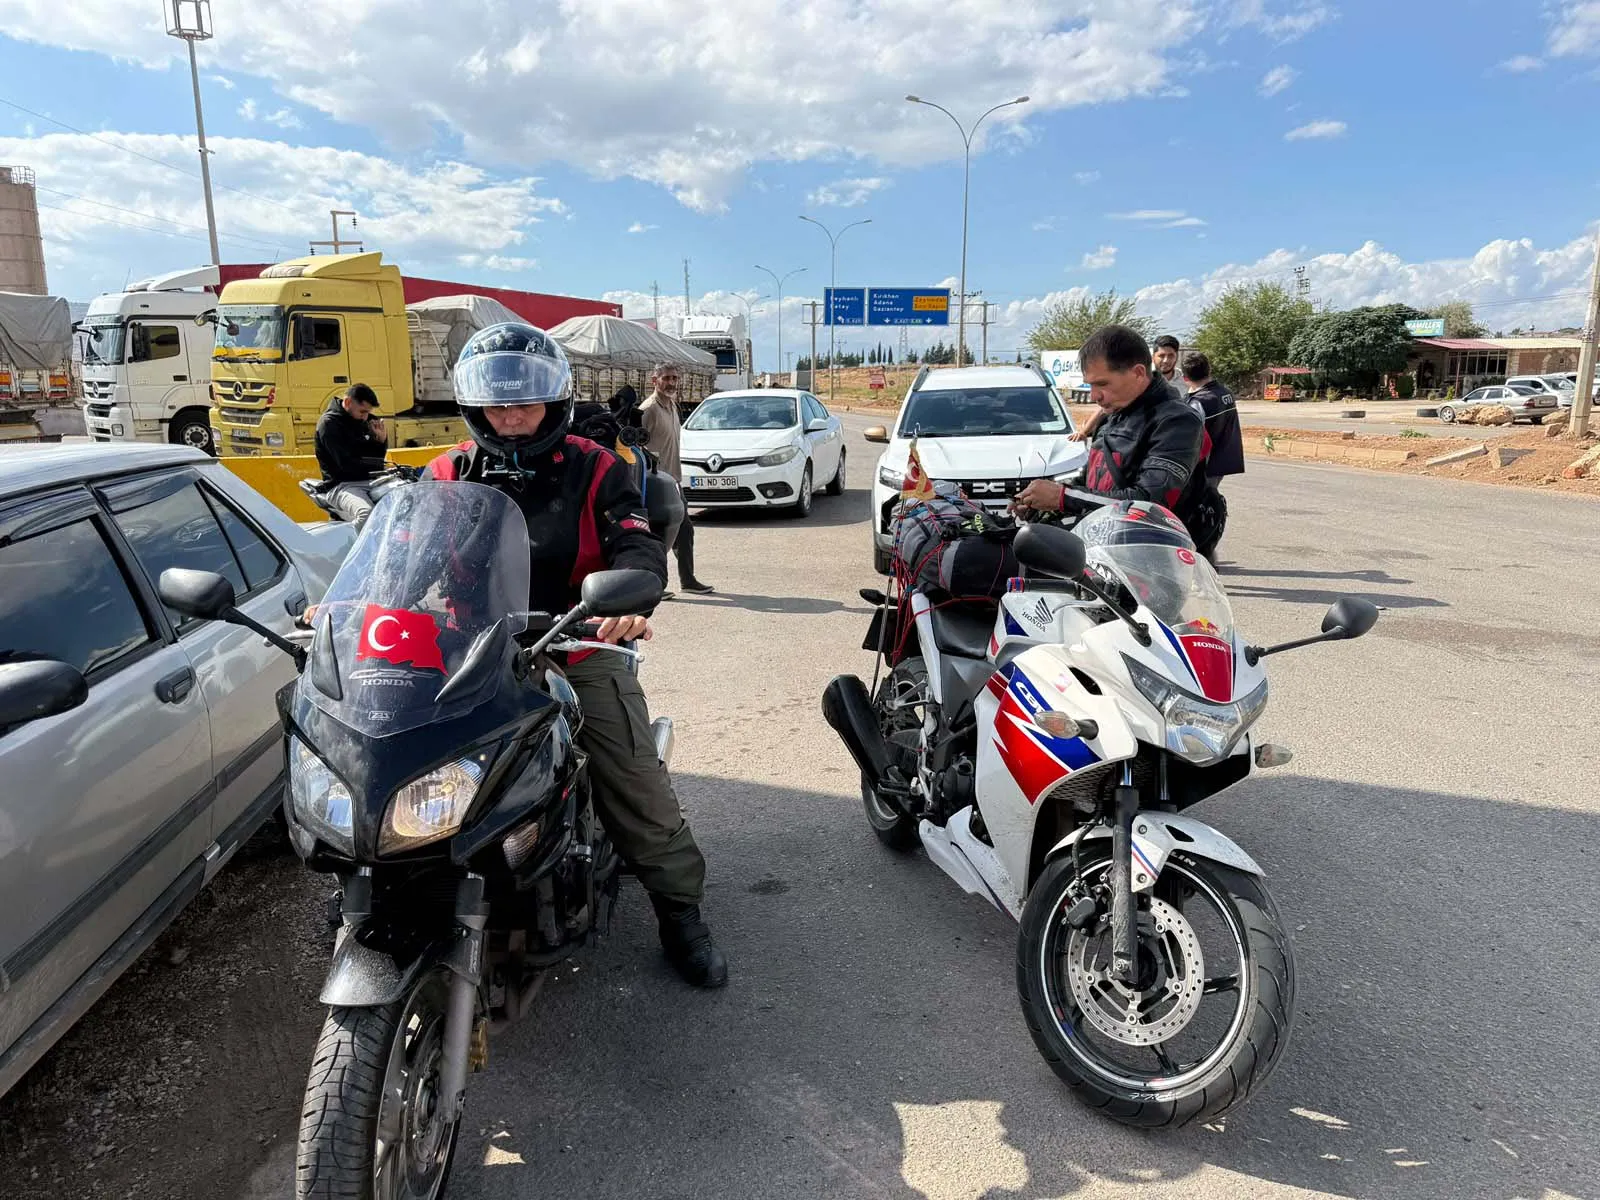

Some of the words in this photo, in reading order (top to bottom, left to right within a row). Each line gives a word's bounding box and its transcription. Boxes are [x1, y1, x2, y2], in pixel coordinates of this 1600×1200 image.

[490, 379, 523, 389] NOLAN
[695, 478, 704, 487] 31
[707, 478, 718, 487] ND
[721, 477, 737, 486] 308
[1022, 611, 1046, 633] HONDA
[1192, 641, 1226, 653] HONDA
[362, 678, 416, 688] HONDA
